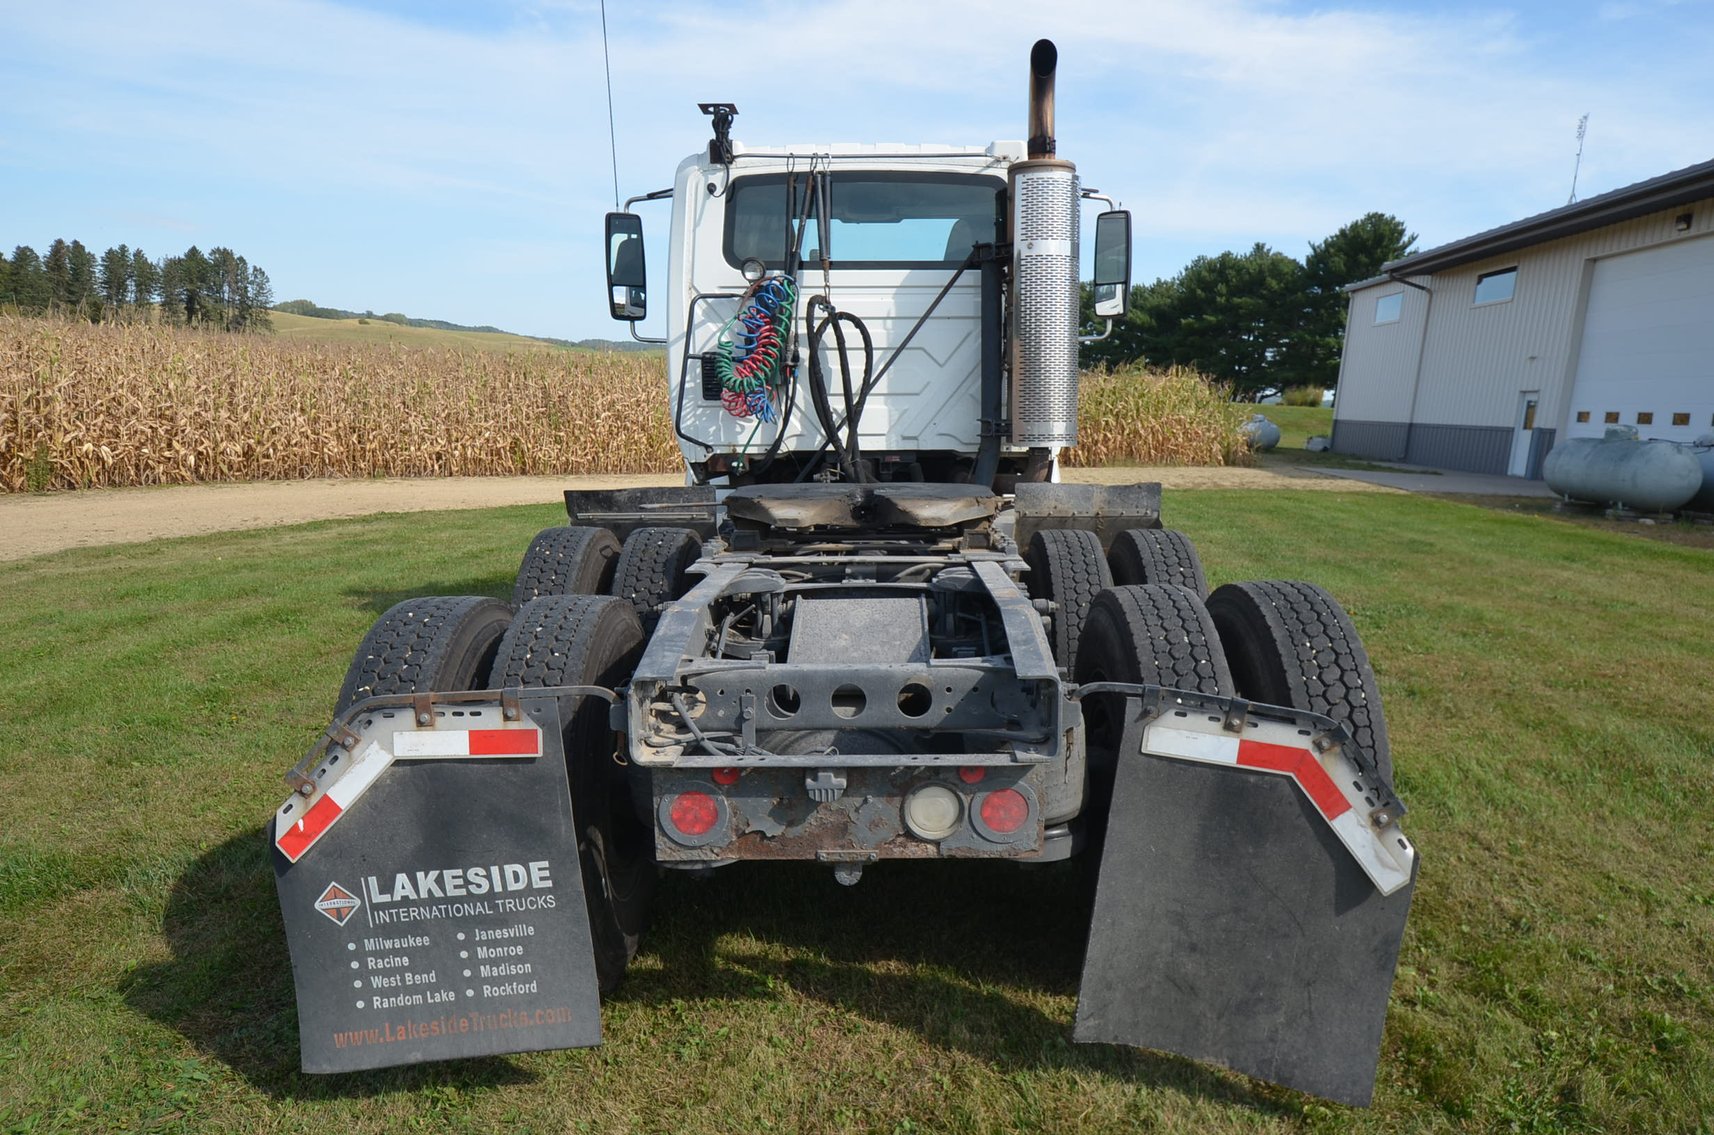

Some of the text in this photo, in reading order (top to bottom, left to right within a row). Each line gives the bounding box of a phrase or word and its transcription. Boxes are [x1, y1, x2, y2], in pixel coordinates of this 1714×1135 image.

[368, 861, 553, 903] LAKESIDE
[374, 895, 556, 924] INTERNATIONAL TRUCKS
[475, 924, 535, 941] Janesville
[364, 935, 430, 951] Milwaukee
[477, 945, 523, 959] Monroe
[367, 955, 410, 969] Racine
[480, 963, 532, 978] Madison
[370, 970, 437, 989] West Bend
[483, 980, 537, 997] Rockford
[373, 989, 455, 1009] Random Lake
[334, 1006, 572, 1048] www.LakesideTrucks.com
